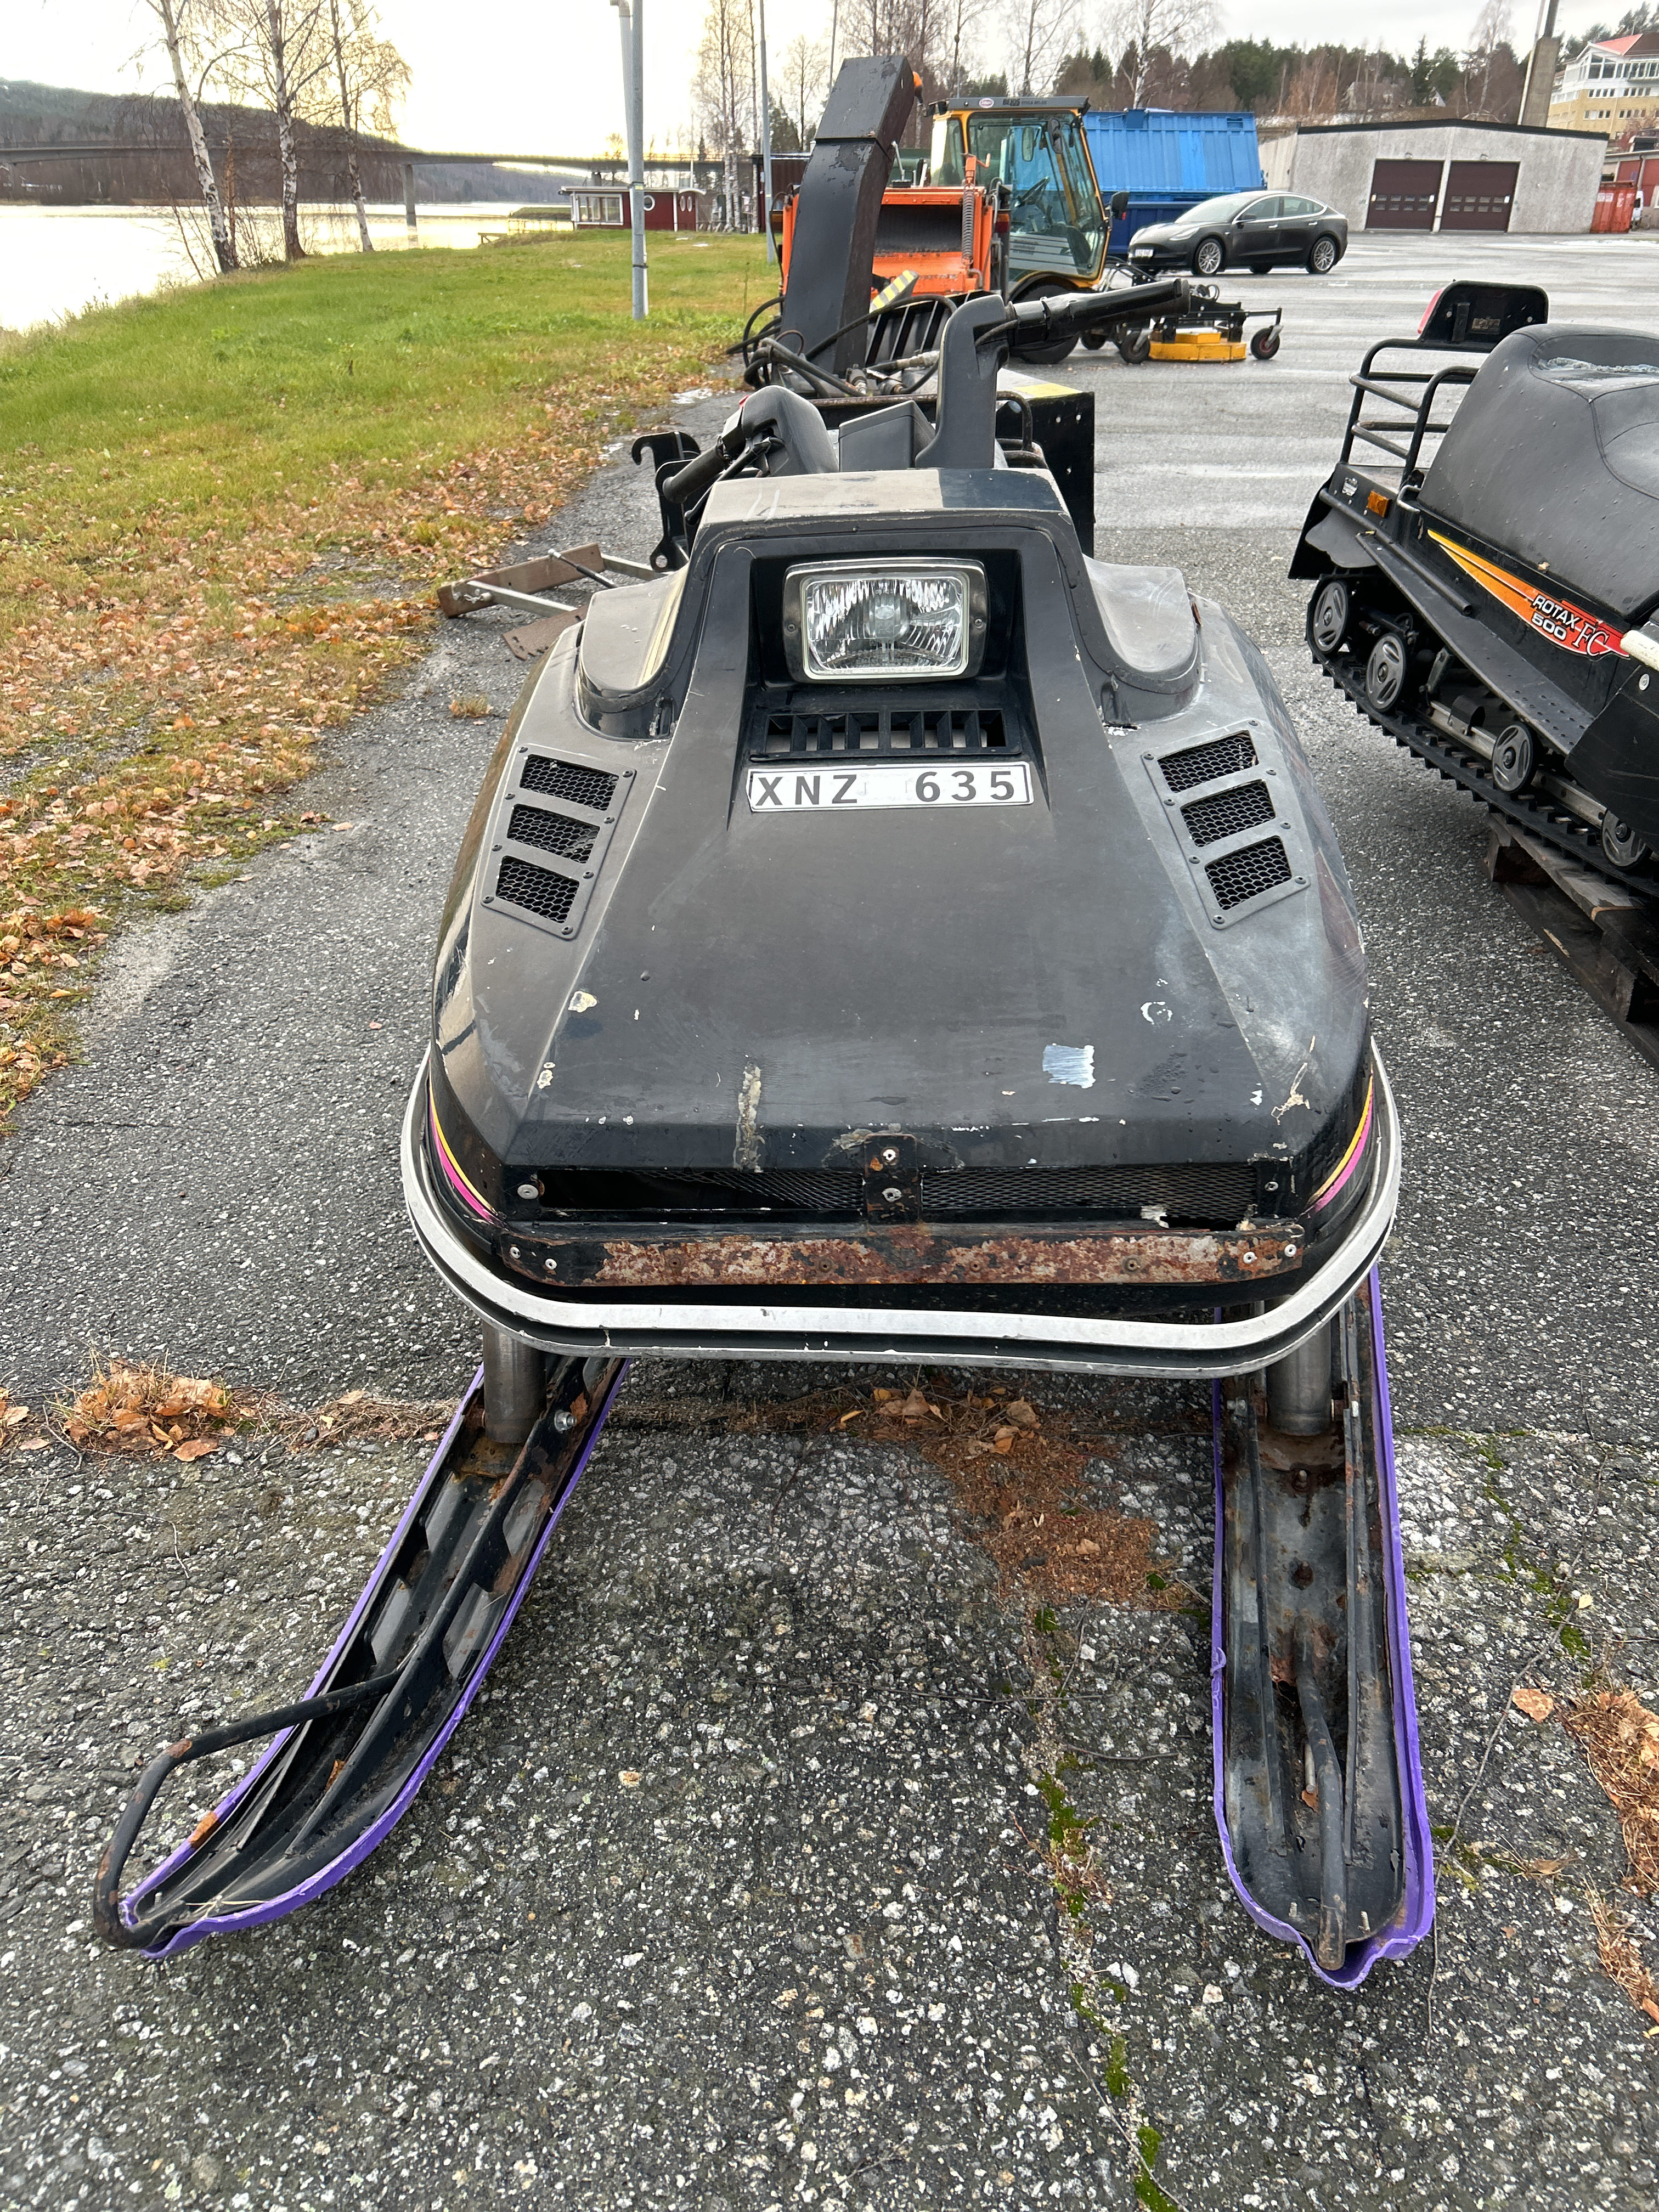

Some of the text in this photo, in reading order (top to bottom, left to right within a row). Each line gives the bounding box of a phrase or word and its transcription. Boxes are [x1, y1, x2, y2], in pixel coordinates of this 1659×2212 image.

[1531, 594, 1582, 631] ROTAX
[1531, 612, 1611, 657] 500 FC
[754, 770, 1015, 806] XNZ 635
